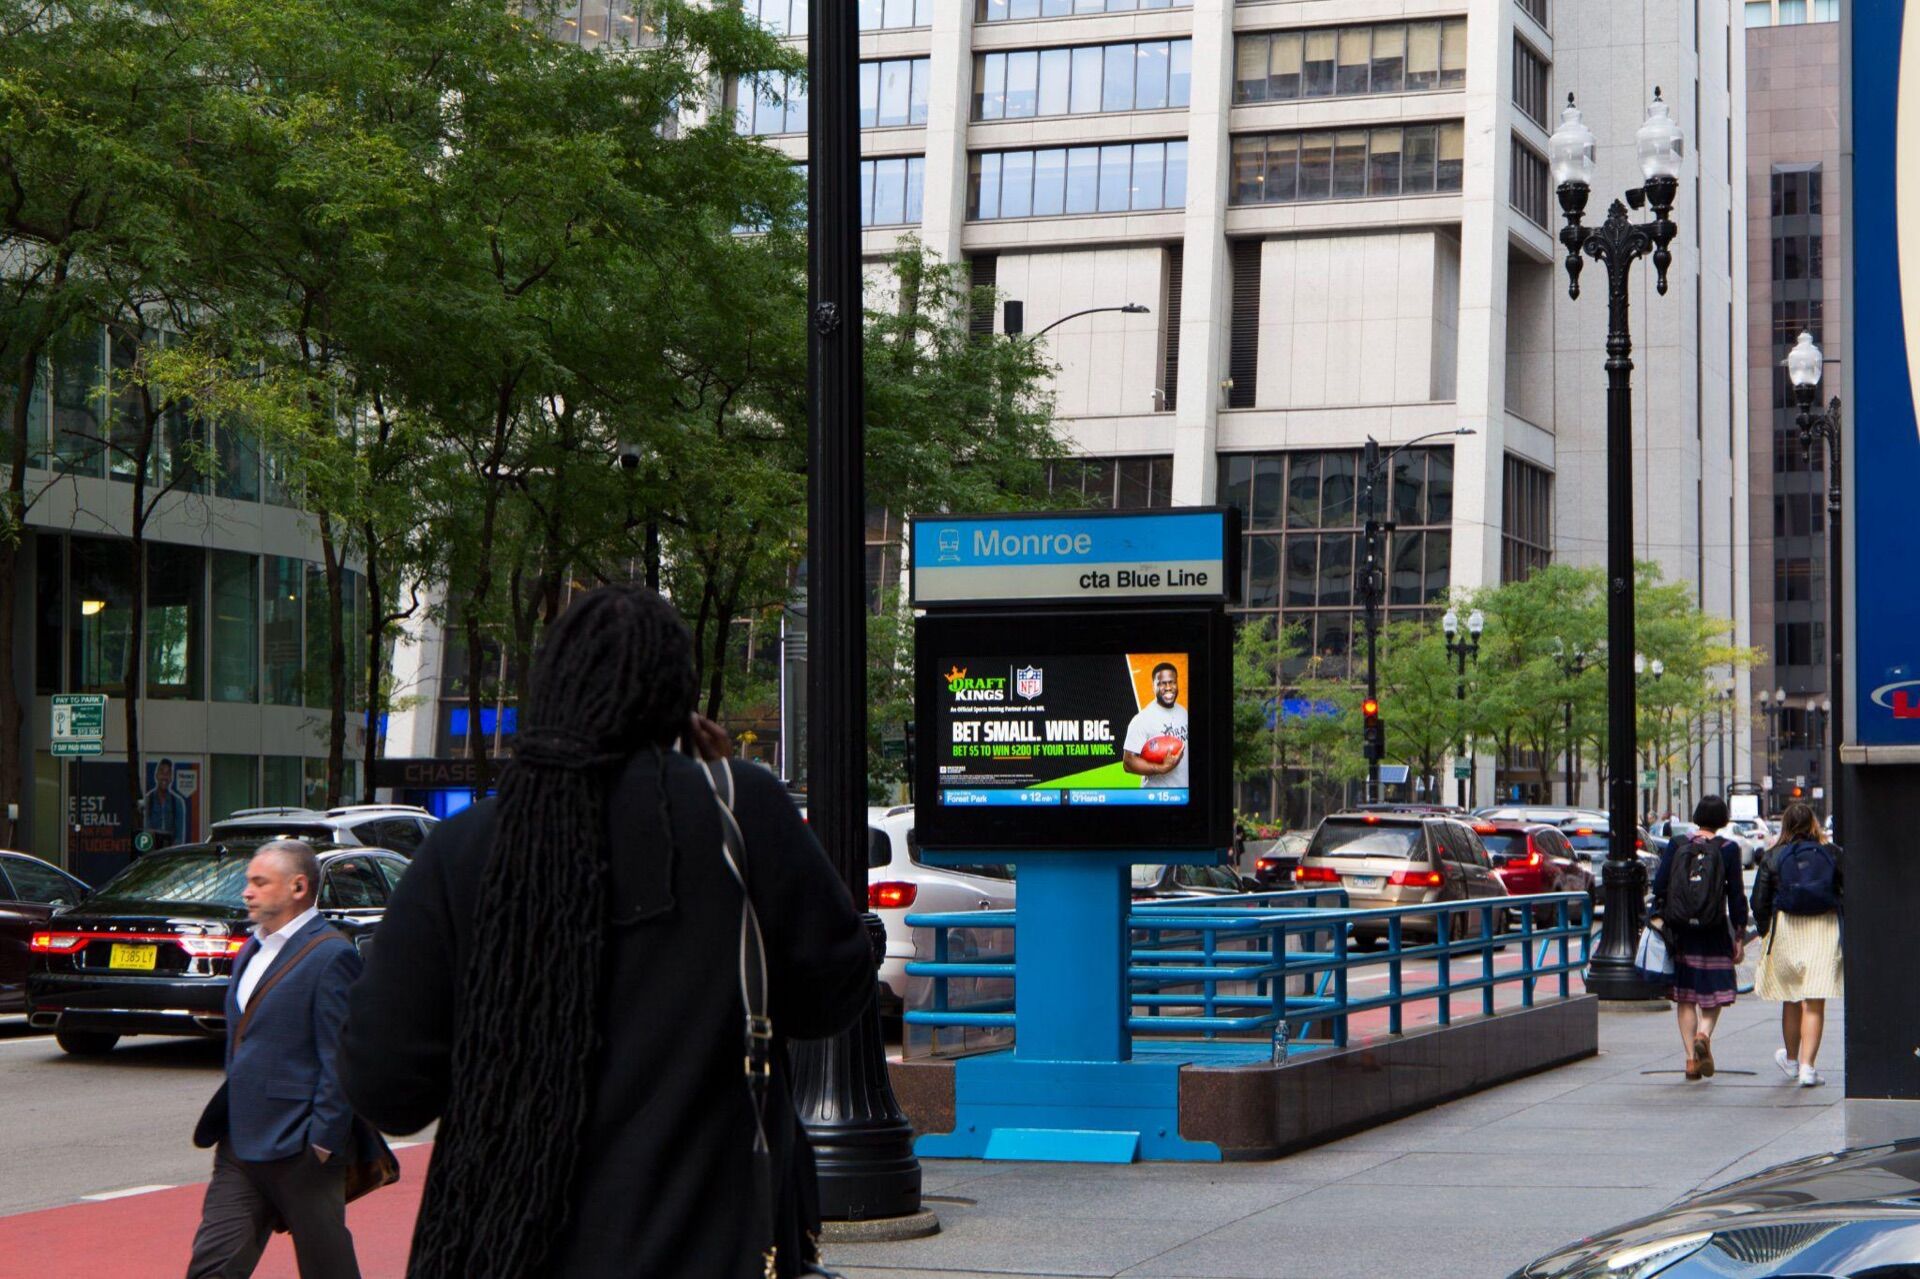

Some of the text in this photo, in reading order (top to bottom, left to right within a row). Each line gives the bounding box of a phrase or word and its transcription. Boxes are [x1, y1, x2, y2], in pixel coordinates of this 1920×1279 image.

[973, 529, 1092, 557] Monroe
[1079, 569, 1209, 589] cta Blue Line
[948, 677, 1006, 692] DRAFT
[1020, 680, 1039, 694] NFL
[55, 696, 69, 705] PAY
[81, 696, 100, 704] PARK
[955, 688, 1004, 701] KINGS
[952, 719, 1115, 743] BET SMALL. WIN BIG.
[952, 743, 1116, 757] BET $5 TO WIN $200 IF YOUR TEAM WINS.
[405, 763, 477, 782] CHASE
[947, 794, 987, 803] Forest Park
[1029, 791, 1042, 803] 12
[120, 950, 141, 963] 7385
[142, 952, 154, 964] LY
